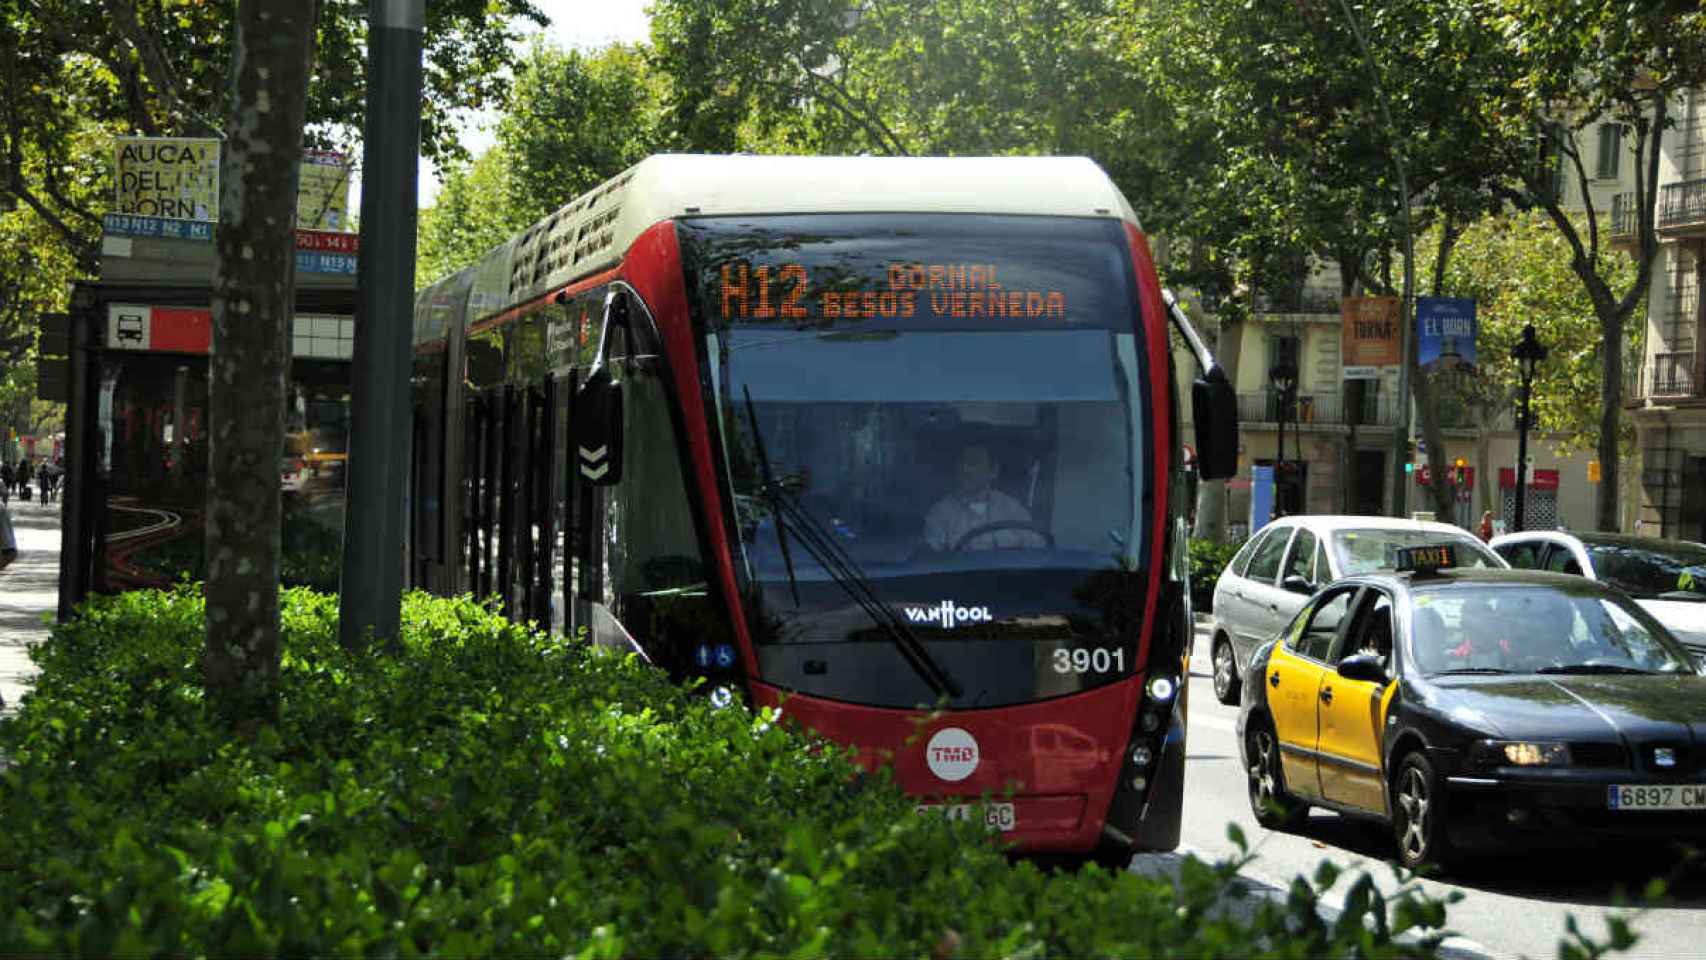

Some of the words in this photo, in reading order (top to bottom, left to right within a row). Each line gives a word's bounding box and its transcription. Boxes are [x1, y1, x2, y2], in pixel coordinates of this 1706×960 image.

[120, 144, 196, 165] AUCA
[720, 263, 809, 319] H12
[931, 291, 1066, 318] VERNEDA
[1053, 647, 1125, 675] 3901
[931, 747, 973, 763] TMB
[1621, 787, 1673, 807] 6897
